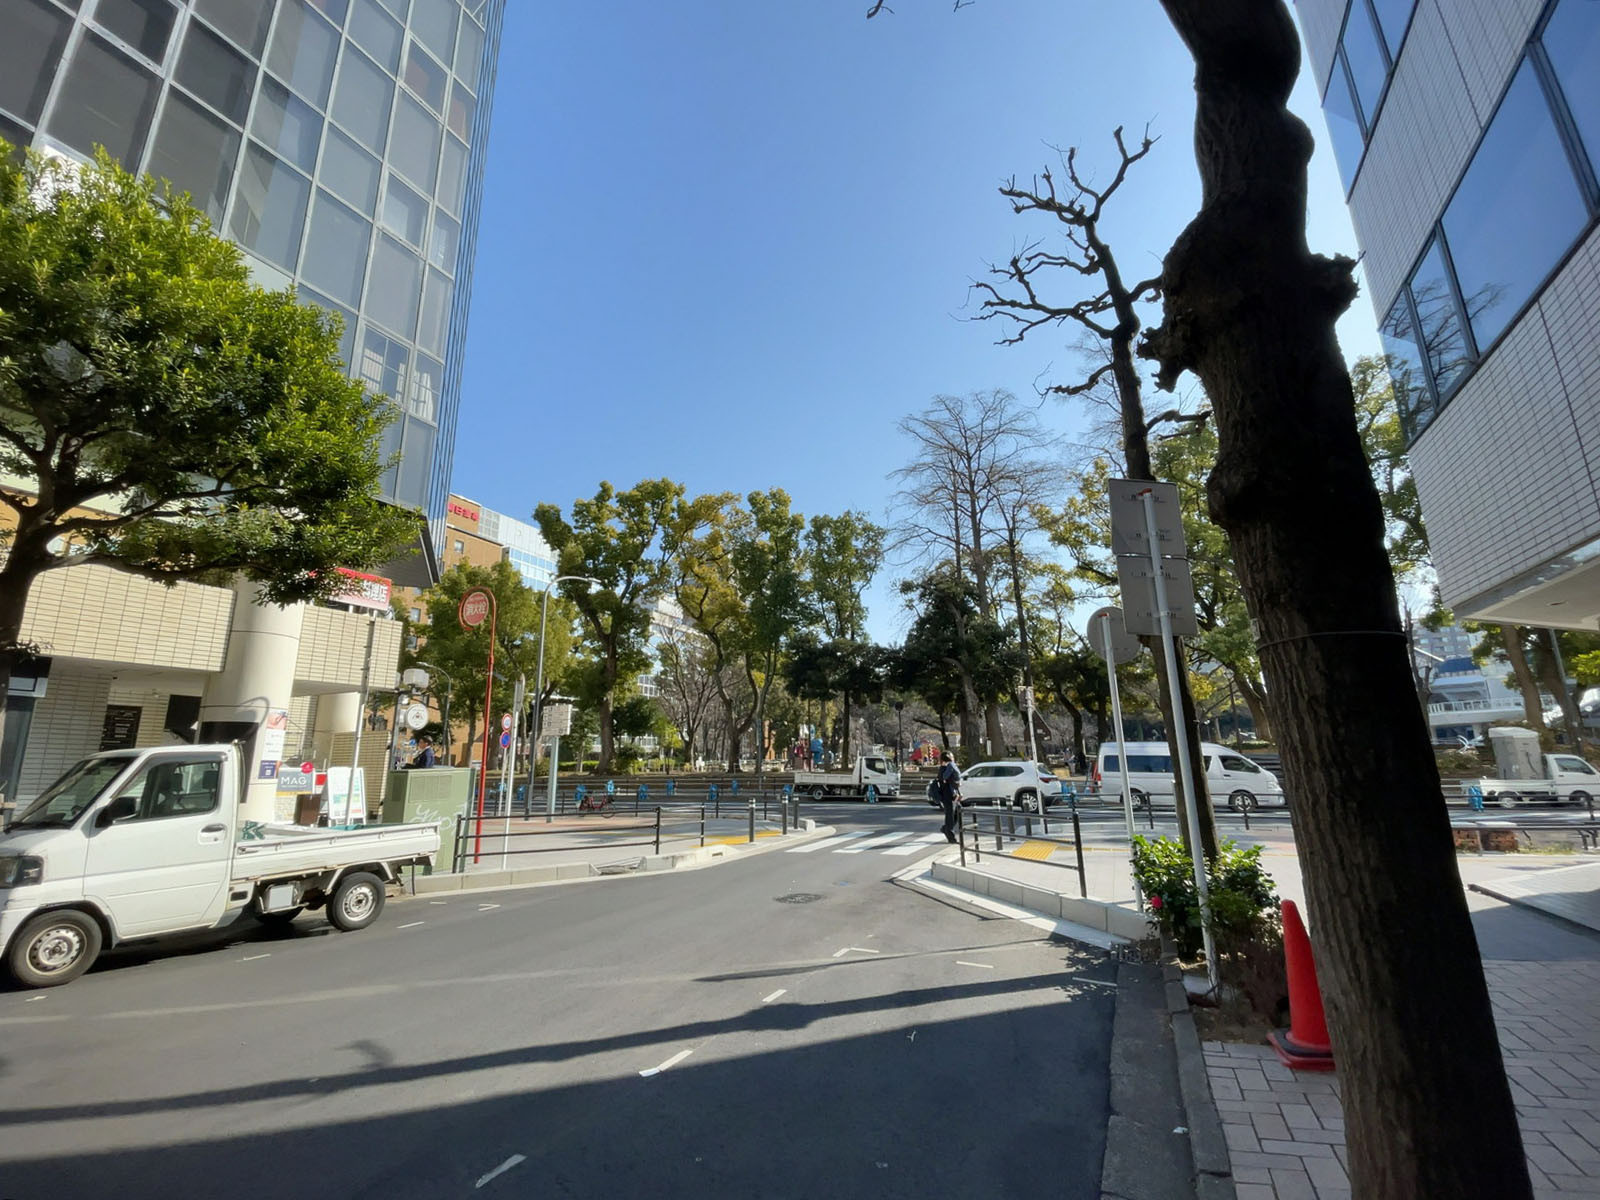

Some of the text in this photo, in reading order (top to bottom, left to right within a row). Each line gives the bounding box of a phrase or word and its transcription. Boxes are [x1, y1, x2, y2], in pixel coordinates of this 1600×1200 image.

[465, 601, 487, 616] 消火栓
[280, 776, 307, 785] MAG
